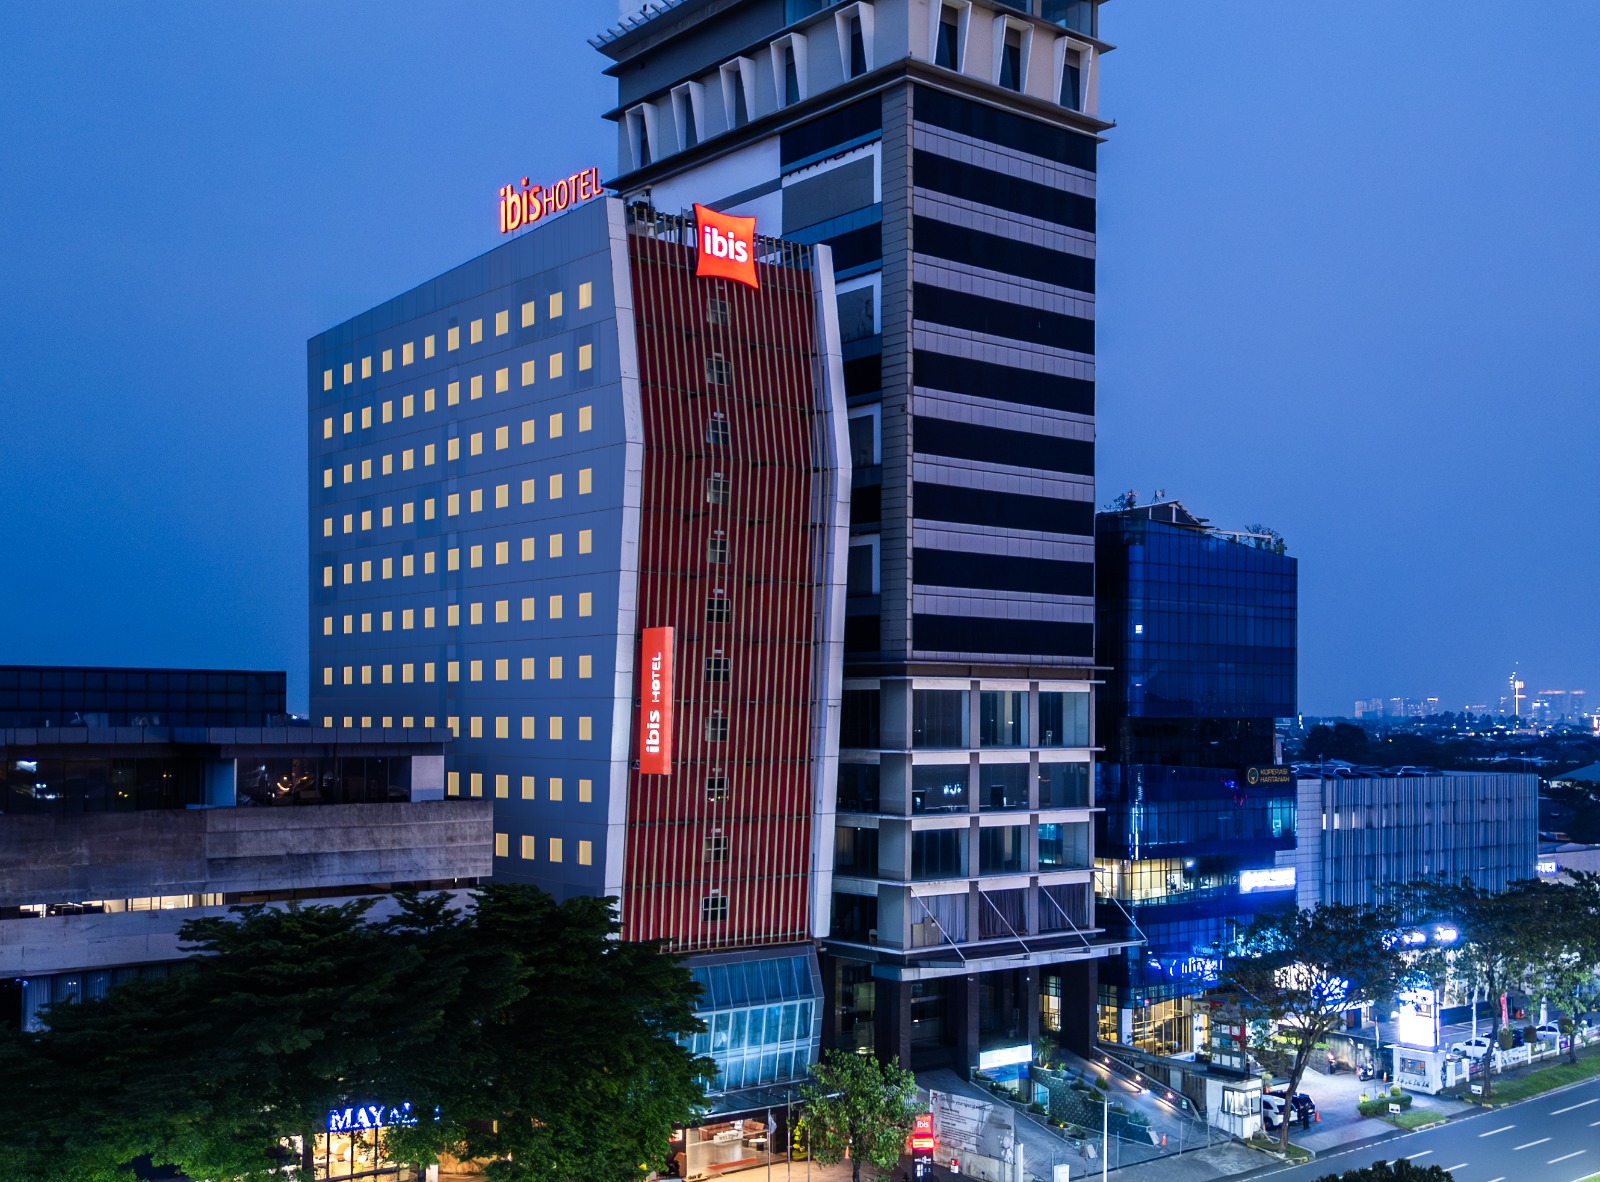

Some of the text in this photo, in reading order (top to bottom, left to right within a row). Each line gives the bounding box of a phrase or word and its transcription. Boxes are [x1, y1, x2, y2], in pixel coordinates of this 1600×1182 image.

[703, 225, 748, 263] ibis
[645, 651, 662, 753] ibis HOTEL
